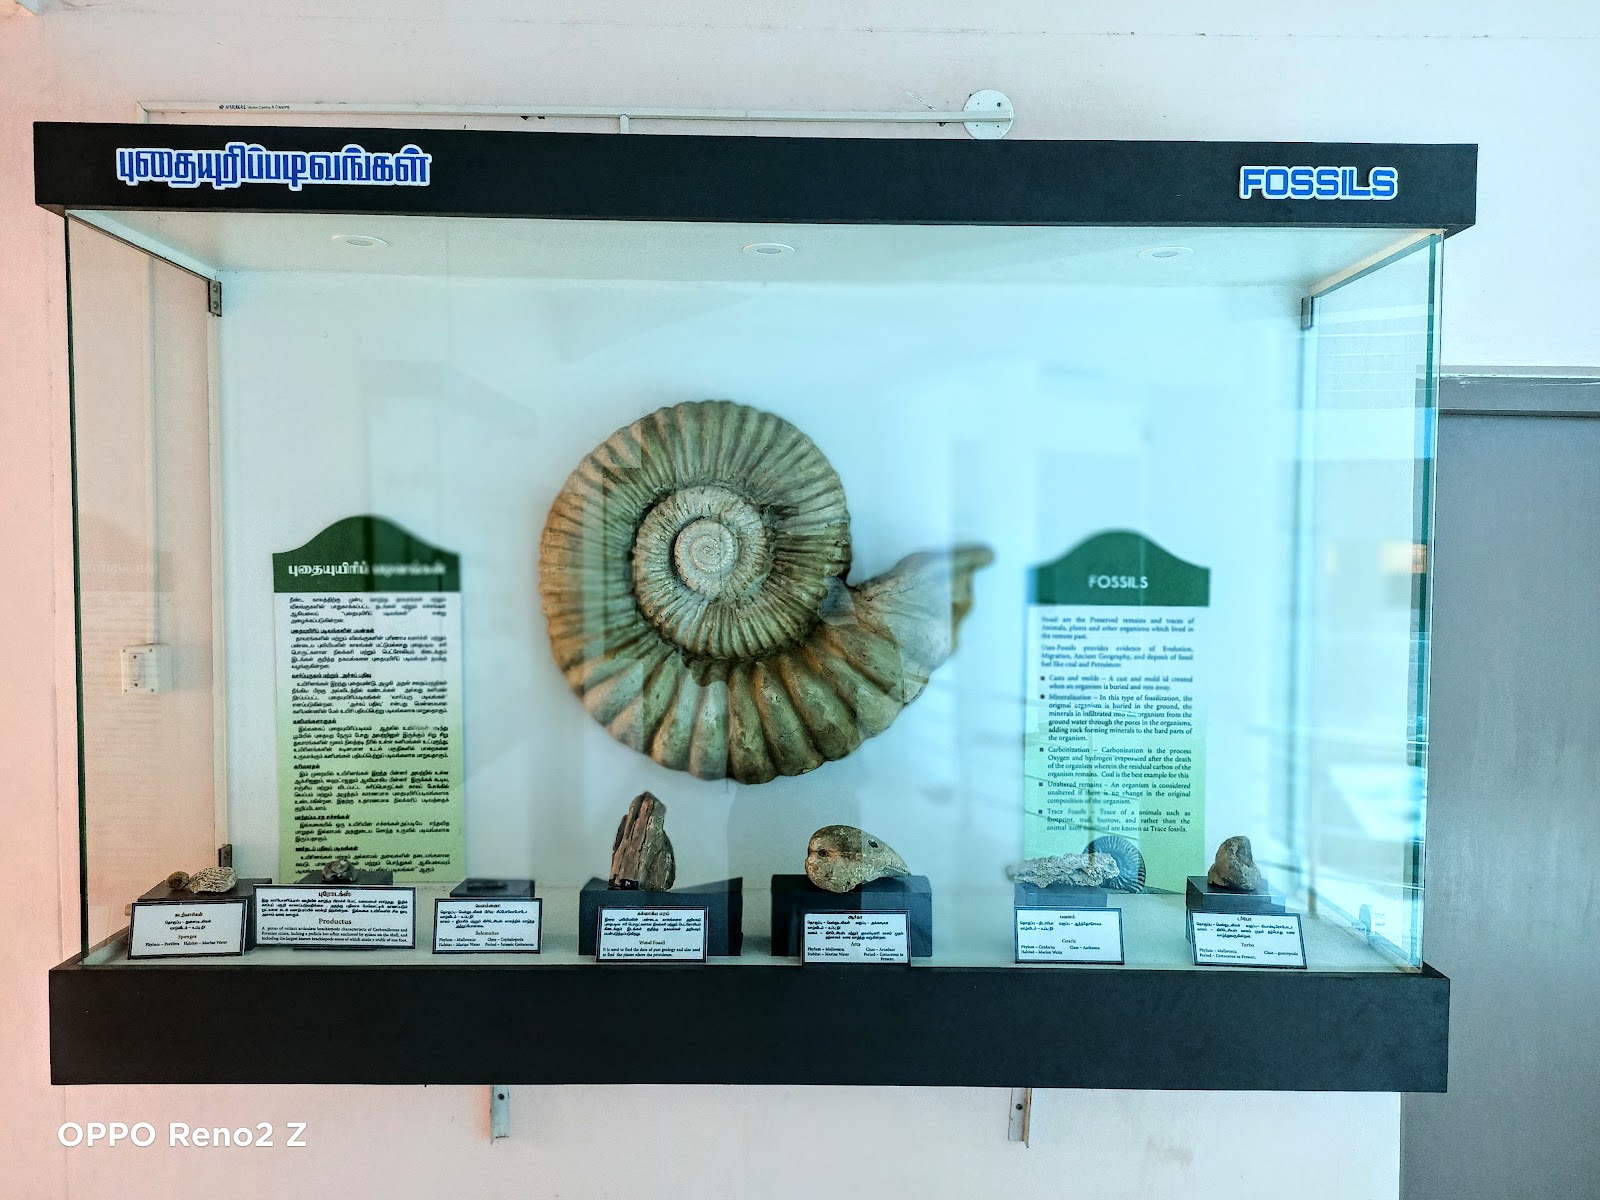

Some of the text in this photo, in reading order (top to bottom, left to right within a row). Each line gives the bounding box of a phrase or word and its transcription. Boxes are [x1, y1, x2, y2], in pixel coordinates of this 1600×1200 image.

[117, 142, 432, 191] புதையுரிப்படிவங்கள்
[1239, 166, 1398, 200] FOSSILS
[1088, 575, 1148, 589] FOSSILS
[1122, 695, 1134, 703] type
[1049, 702, 1071, 710] original
[1156, 703, 1179, 711] ground,
[1049, 718, 1070, 727] ground
[1089, 718, 1112, 727] through
[1160, 720, 1192, 728] organisms,
[1049, 726, 1068, 735] adding
[1084, 727, 1108, 735] forming
[1170, 728, 1184, 736] parts
[1048, 754, 1069, 763] Oxygen
[1085, 755, 1112, 763] hydrogen
[1065, 763, 1092, 771] organism
[1048, 771, 1073, 779] organism
[1144, 771, 1166, 780] example
[1122, 782, 1149, 790] organism
[1168, 790, 1190, 798] original
